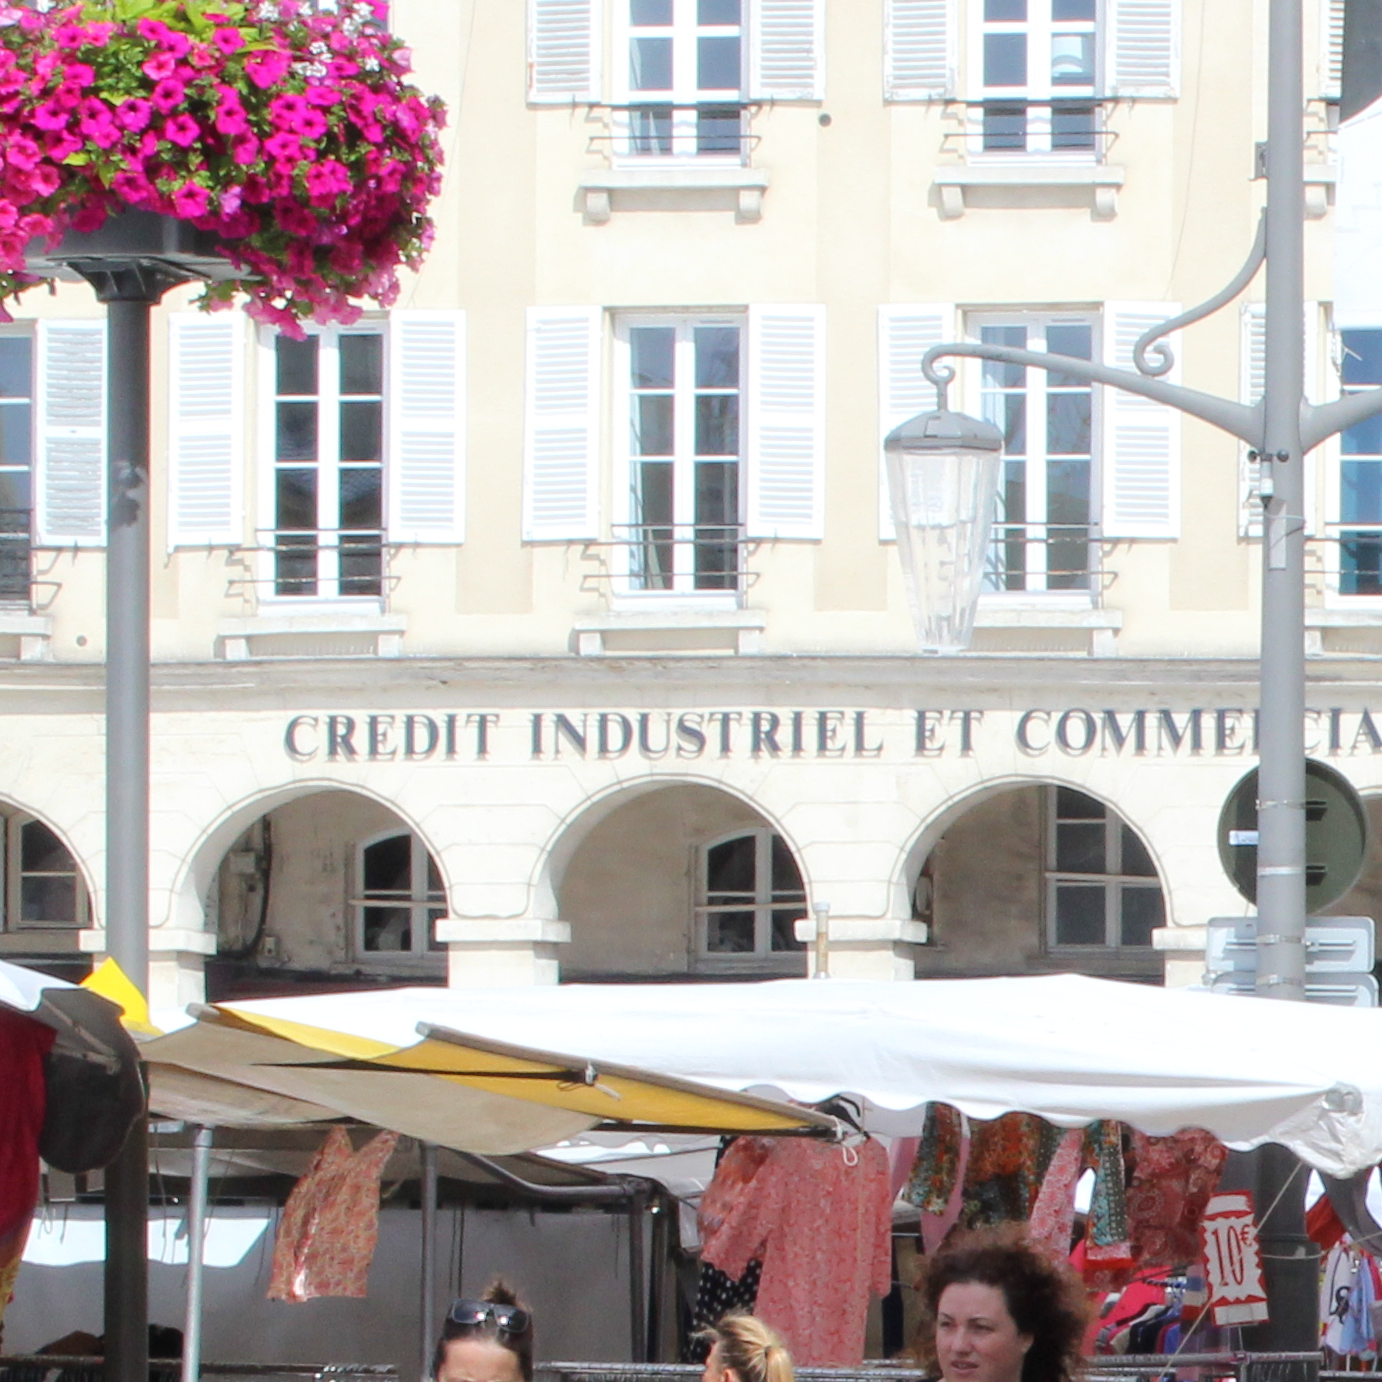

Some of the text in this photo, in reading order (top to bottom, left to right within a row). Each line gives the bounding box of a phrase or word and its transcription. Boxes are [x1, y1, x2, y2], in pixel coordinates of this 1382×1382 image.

[284, 712, 500, 762] CREDIT
[527, 710, 885, 760] INDUSTRIEL
[913, 709, 983, 757] ET
